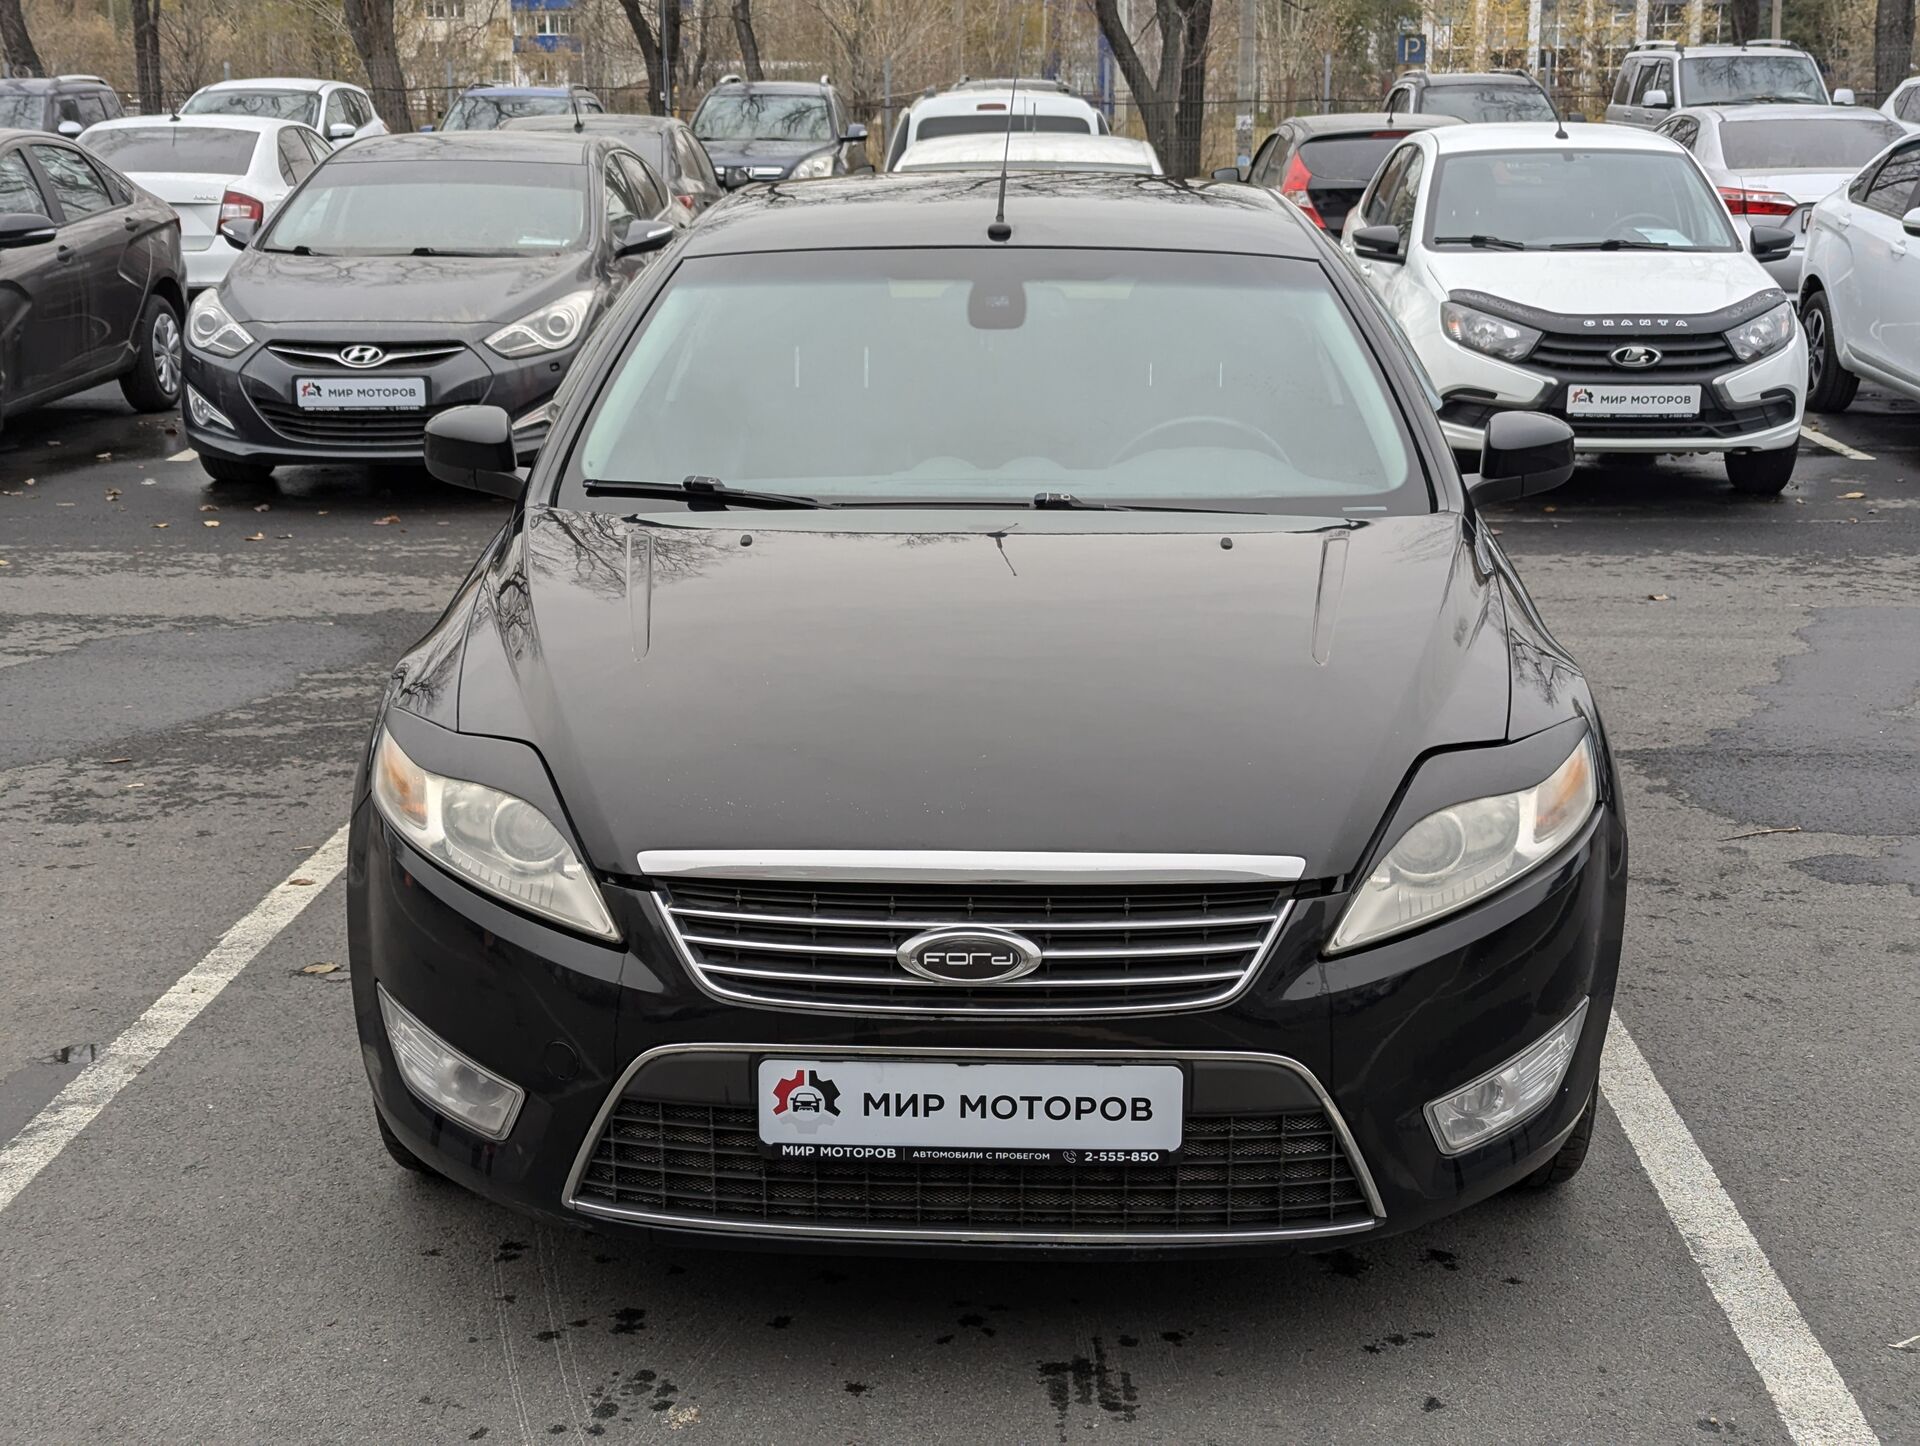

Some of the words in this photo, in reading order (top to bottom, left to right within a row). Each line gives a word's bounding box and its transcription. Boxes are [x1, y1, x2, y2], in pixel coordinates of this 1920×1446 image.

[1404, 37, 1421, 62] P
[1583, 319, 1688, 327] GRANTA
[328, 388, 354, 398] МИР
[357, 388, 417, 398] МОТОРОВ
[1600, 395, 1627, 405] МИР
[1631, 395, 1691, 405] МОТОРОВ
[862, 1092, 945, 1118] МИР
[959, 1094, 1154, 1122] МОТОРОВ
[781, 1145, 815, 1157] МИР
[819, 1146, 897, 1160] МОТОРОВ
[912, 1150, 984, 1160] АВТОМОБИЛИ
[986, 1152, 994, 1160] С
[995, 1151, 1051, 1161] ПРОБЕГОМ
[1083, 1151, 1160, 1163] 2-555-850
